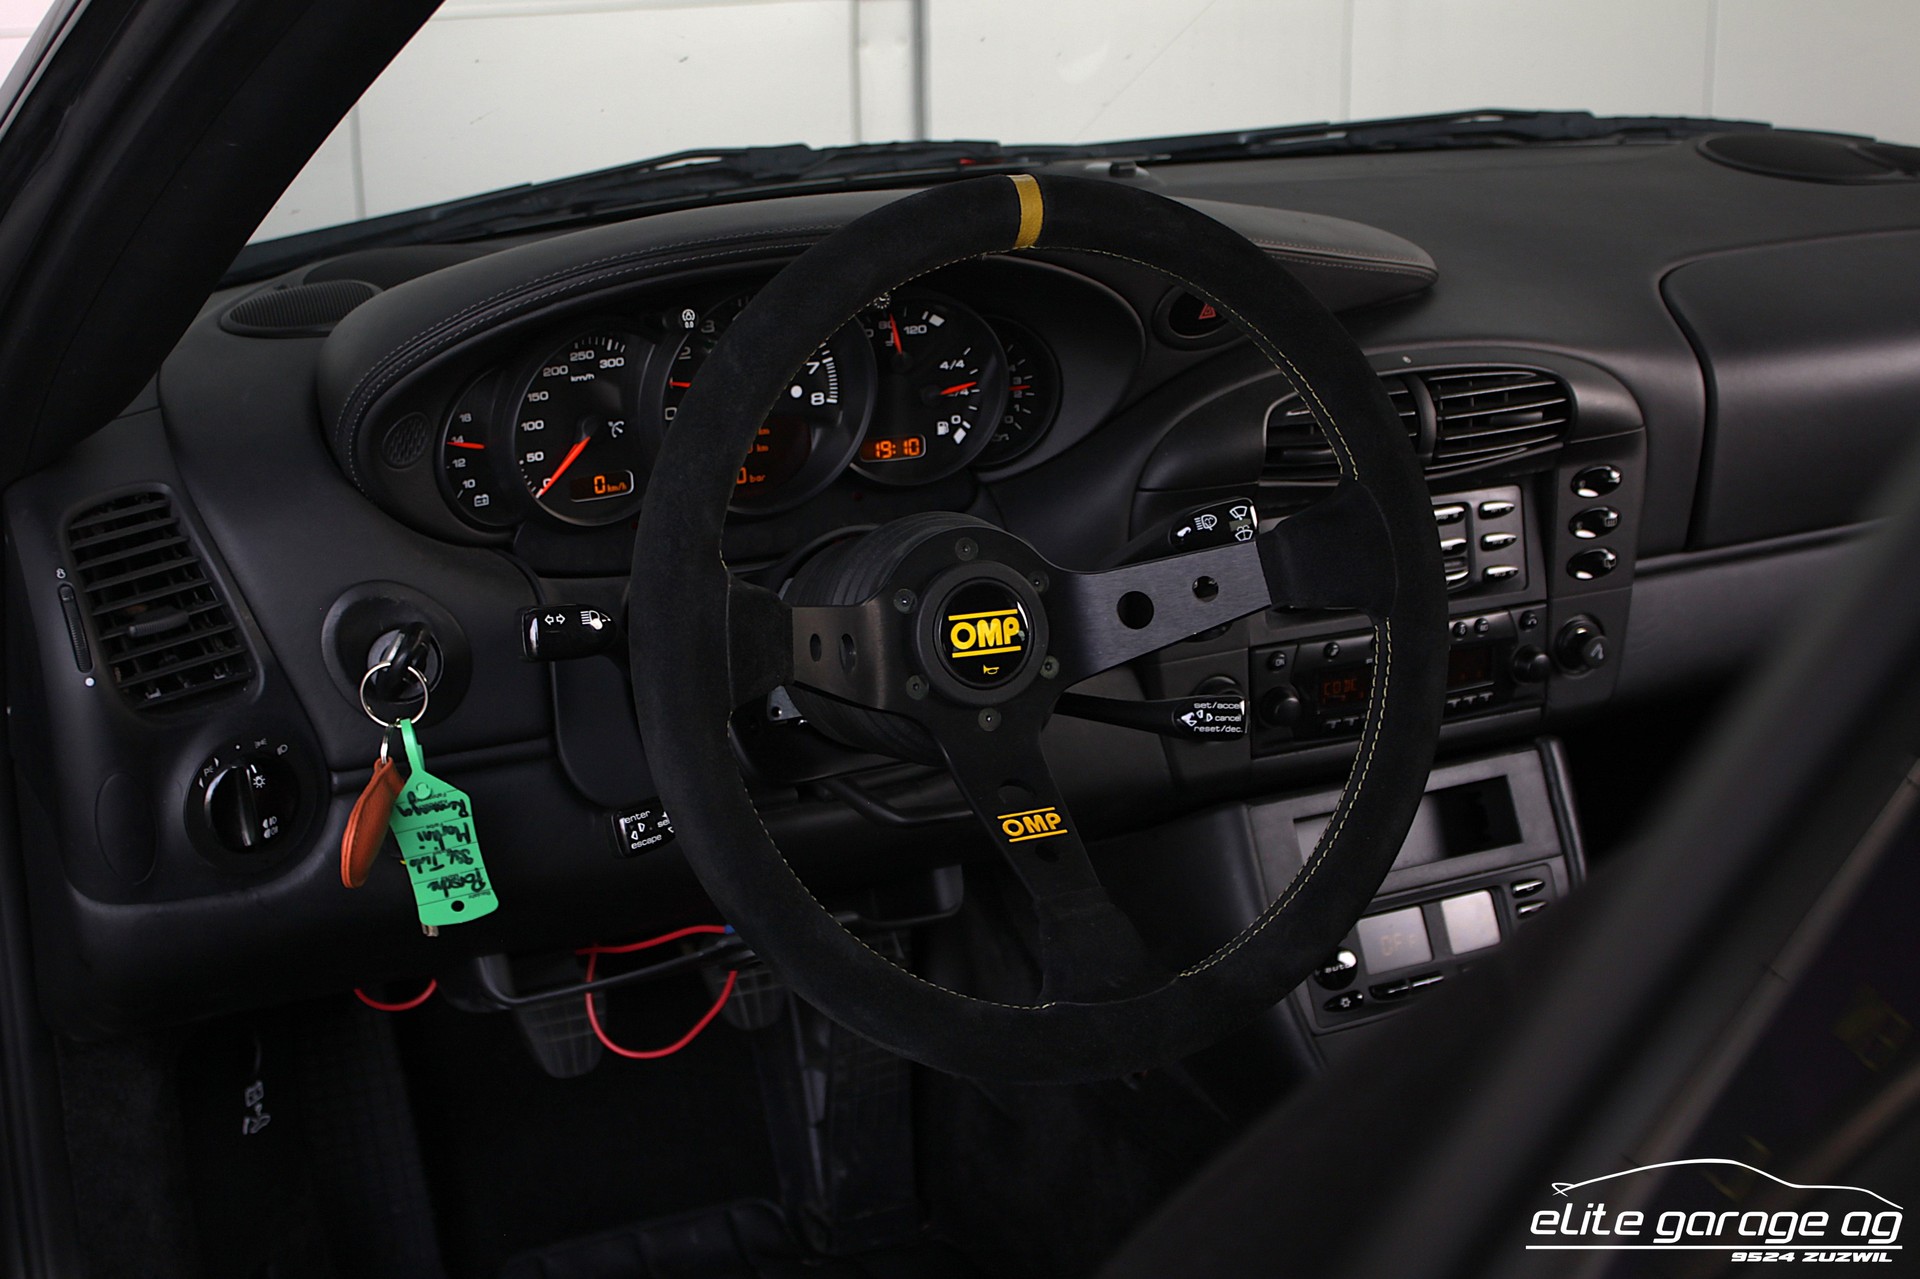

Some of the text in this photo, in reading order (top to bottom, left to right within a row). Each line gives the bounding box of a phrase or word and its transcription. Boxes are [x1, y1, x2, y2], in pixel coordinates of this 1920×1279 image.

[903, 324, 928, 335] 120
[569, 350, 595, 362] 250
[599, 357, 625, 369] 300
[805, 361, 820, 375] 7
[938, 359, 965, 370] 4/4
[542, 365, 569, 378] 200
[570, 373, 595, 382] km/h
[527, 390, 550, 403] 150
[810, 391, 825, 406] 8
[520, 419, 545, 432] 100
[950, 414, 962, 425] 0
[874, 437, 921, 459] 19:10
[452, 457, 467, 469] 12
[525, 451, 545, 463] 50
[462, 478, 477, 489] 10
[593, 474, 606, 495] 0
[950, 616, 1021, 651] OMP
[1214, 713, 1242, 722] cancel
[624, 810, 651, 823] enter
[1002, 812, 1061, 837] OMP
[630, 834, 663, 850] escape
